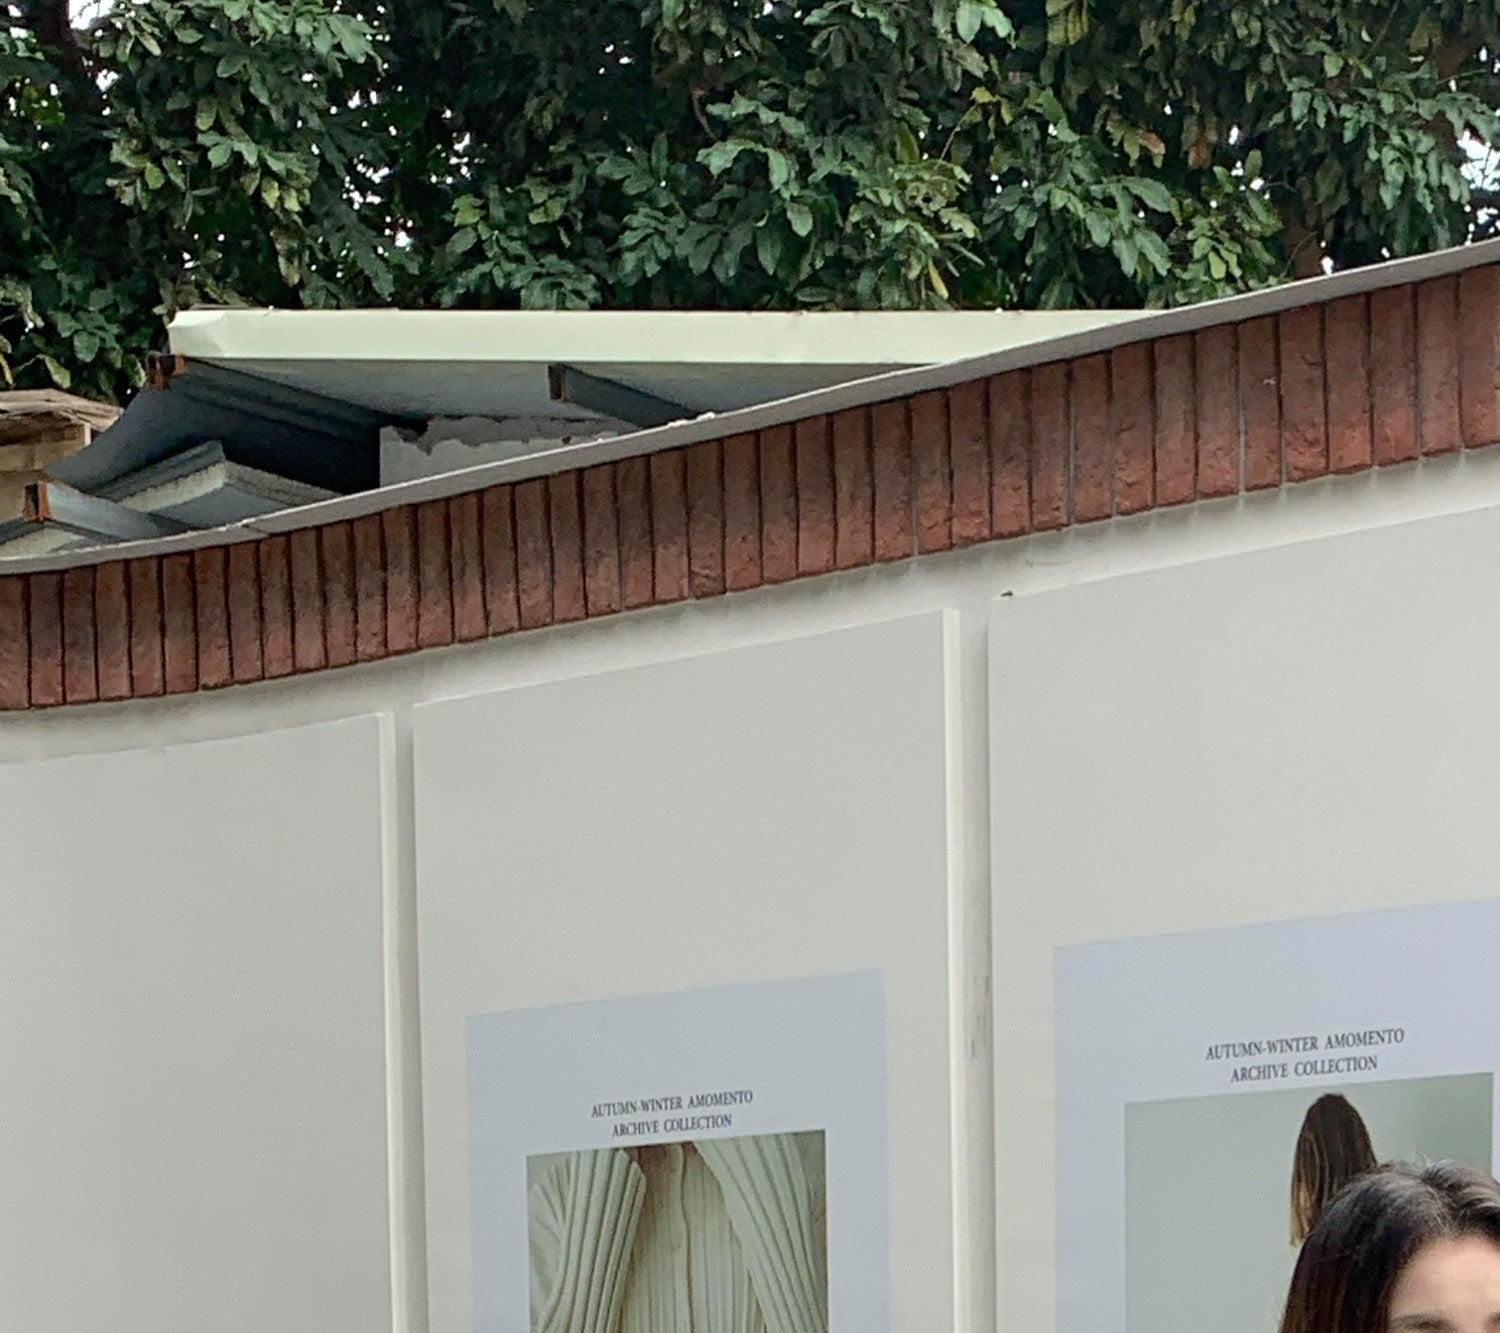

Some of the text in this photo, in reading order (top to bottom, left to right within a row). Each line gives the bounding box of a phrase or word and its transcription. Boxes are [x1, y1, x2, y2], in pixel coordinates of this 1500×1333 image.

[1206, 1028, 1405, 1060] AUTUMN-WINTER AMOMENTO
[1230, 1055, 1378, 1083] ARCHIVE COLLECTION
[591, 1089, 754, 1118] AUTUMN-WINTER AMOMENTO
[611, 1114, 733, 1138] ARCHIVE COLLECTION
